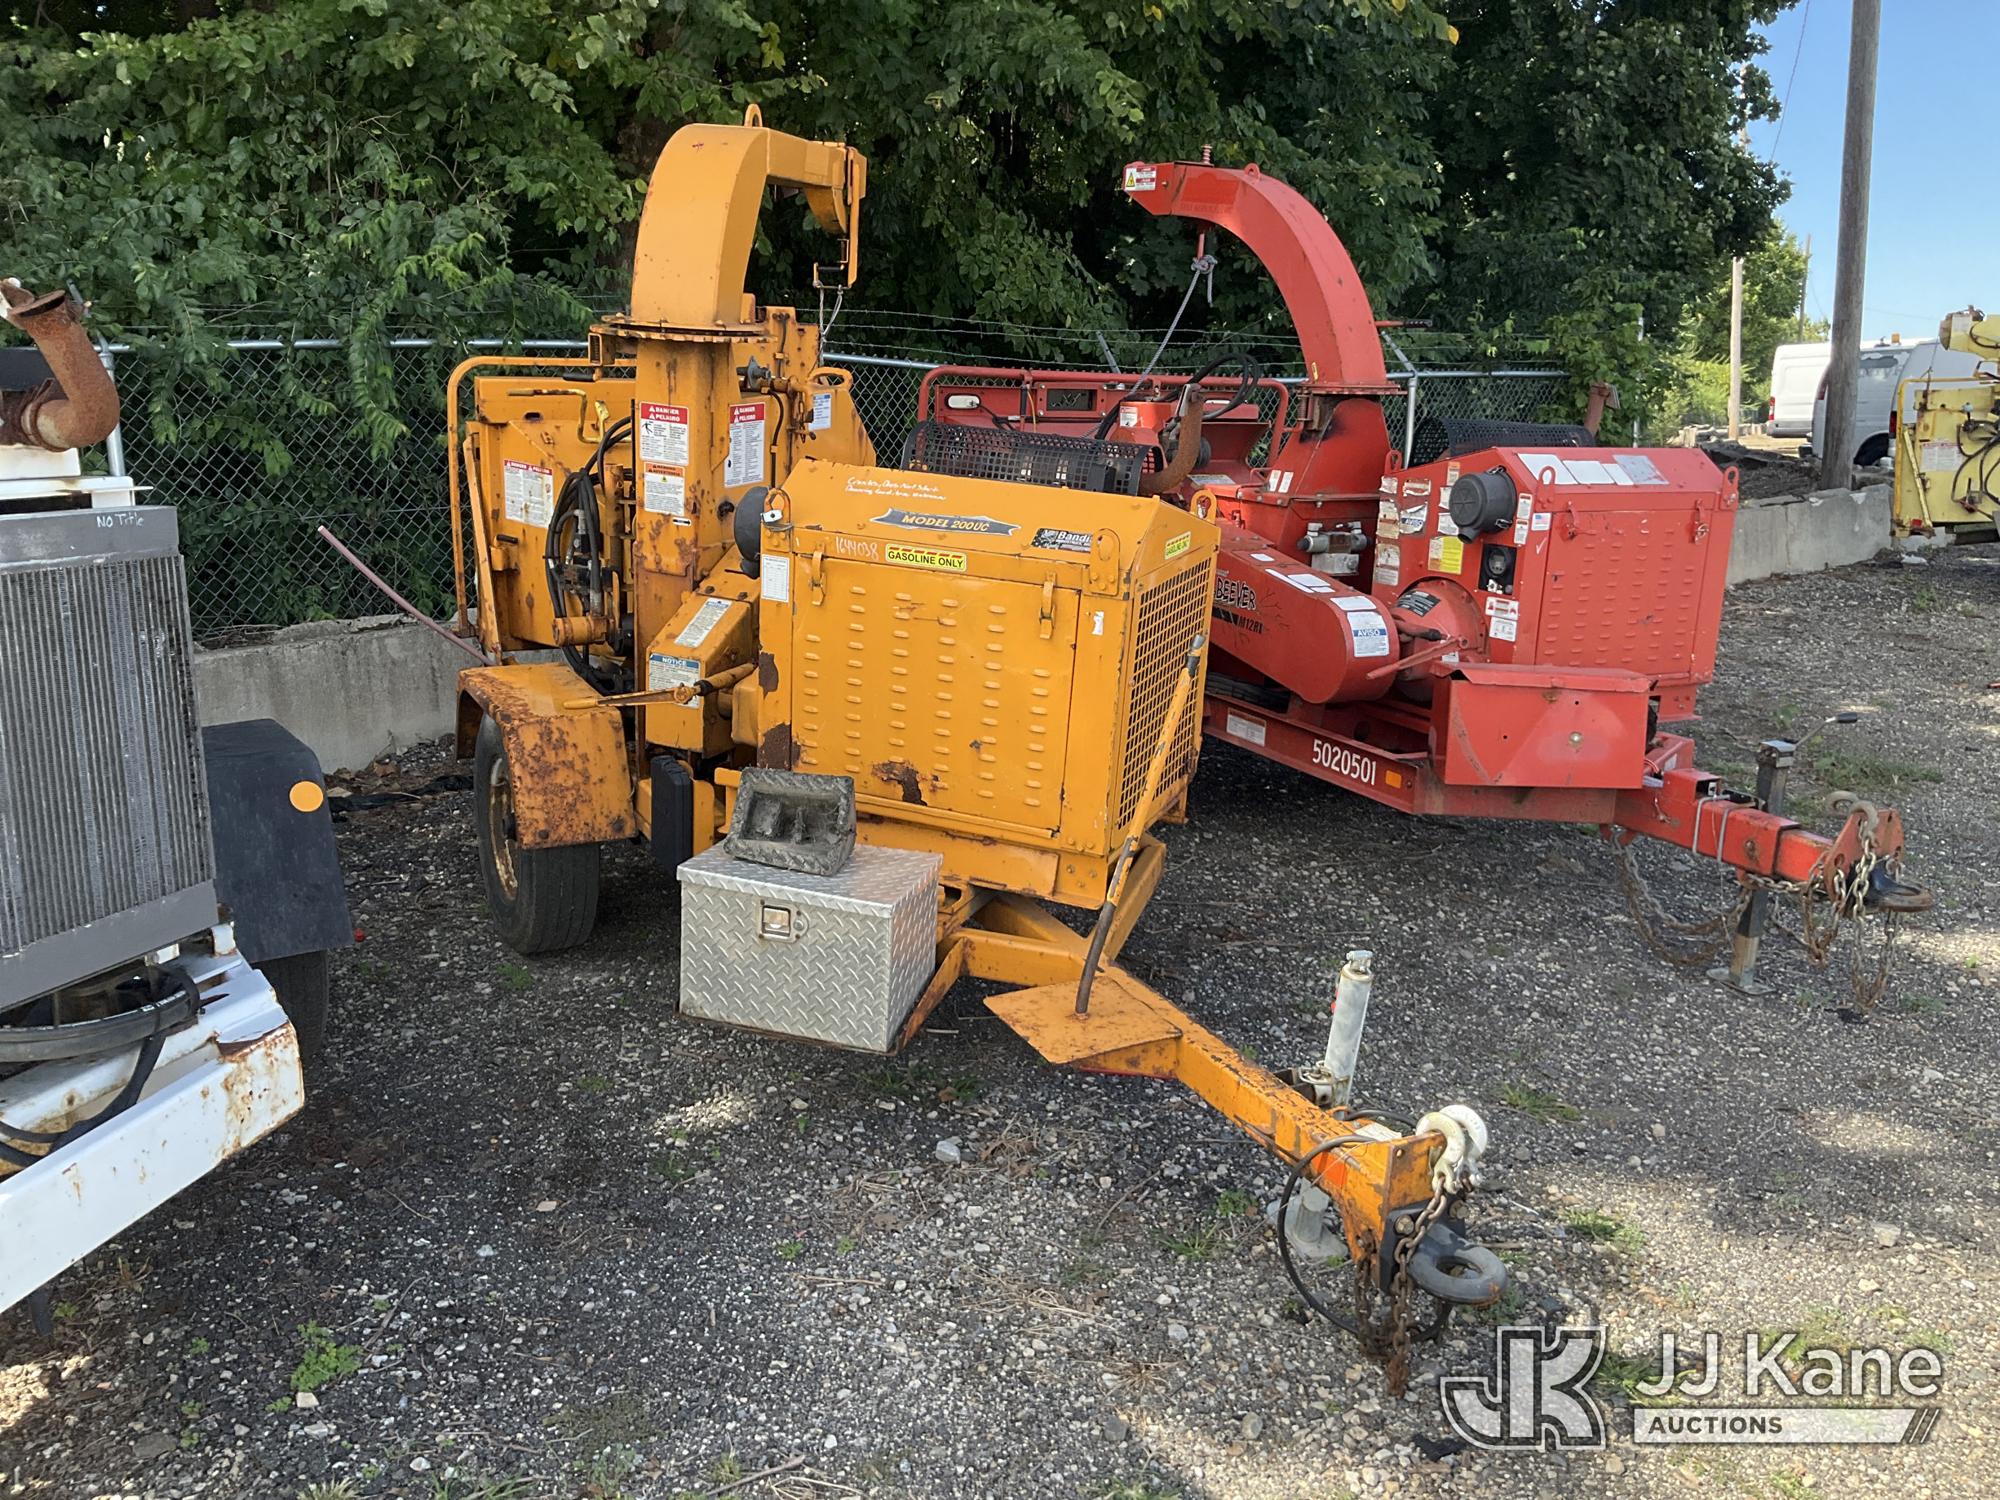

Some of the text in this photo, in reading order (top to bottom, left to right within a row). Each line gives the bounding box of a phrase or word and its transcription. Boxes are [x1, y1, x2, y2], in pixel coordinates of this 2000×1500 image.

[901, 514, 990, 532] MODEL 200UC
[1057, 531, 1092, 543] Bandi
[835, 535, 879, 562] 1644038
[887, 549, 964, 569] GASOLINE ONLY
[1215, 576, 1257, 611] BEEVER
[1357, 629, 1380, 638] AVISO
[662, 657, 687, 666] NOTICE
[1312, 738, 1377, 786] 5020501
